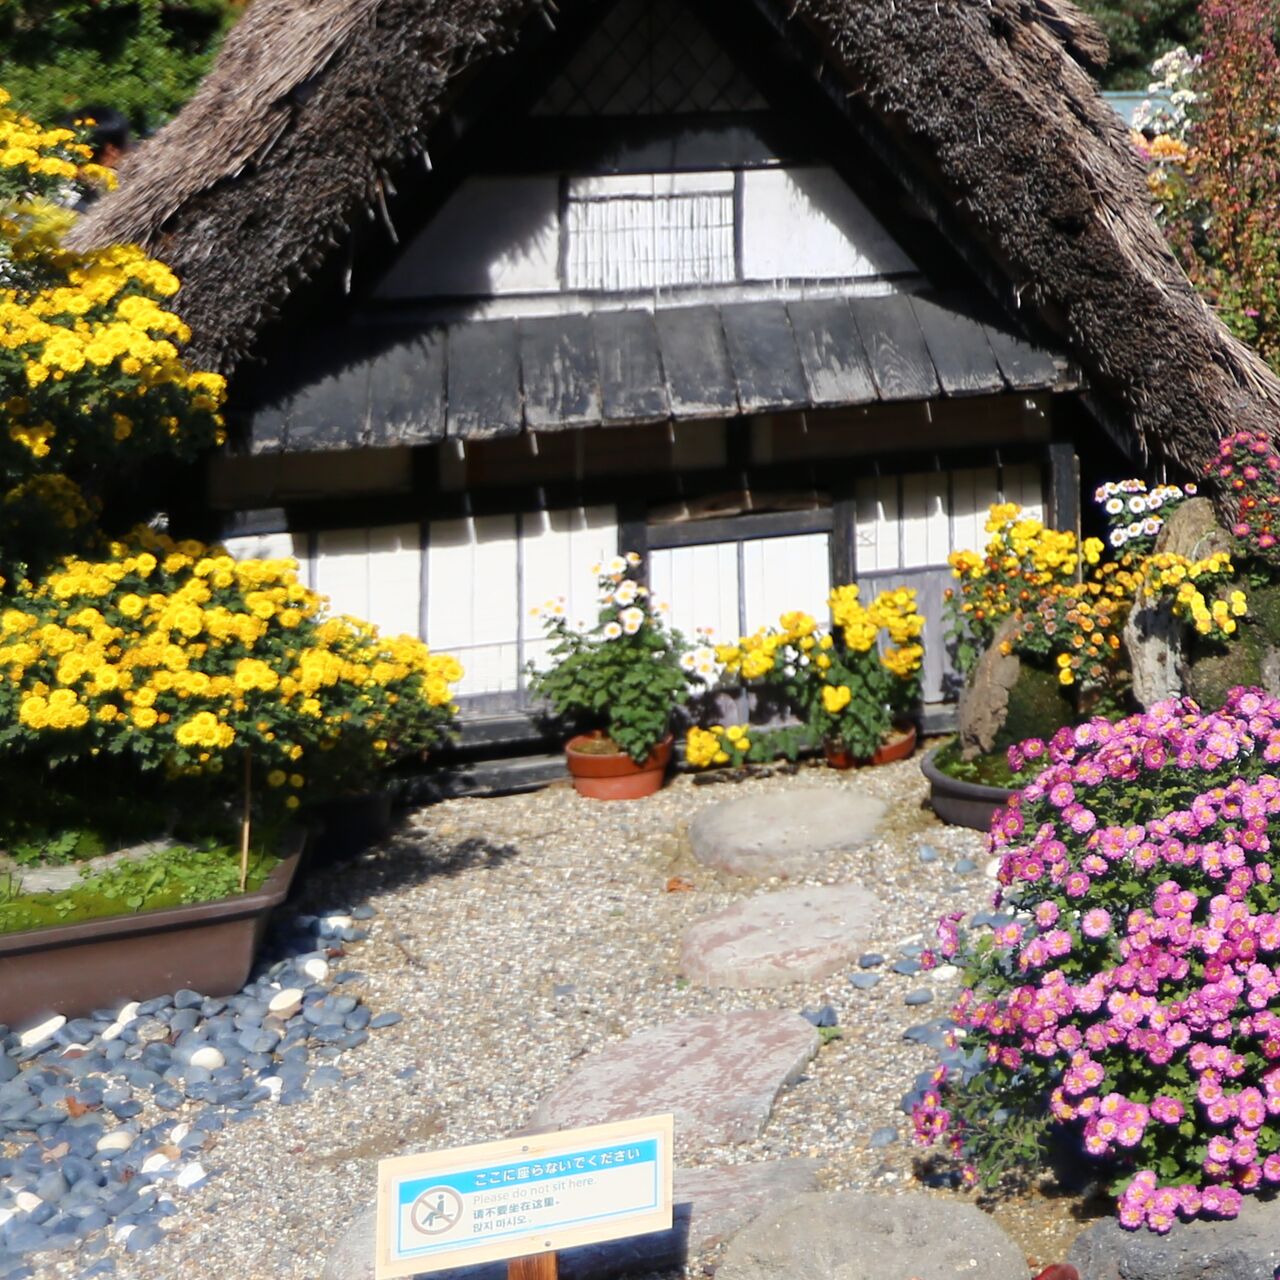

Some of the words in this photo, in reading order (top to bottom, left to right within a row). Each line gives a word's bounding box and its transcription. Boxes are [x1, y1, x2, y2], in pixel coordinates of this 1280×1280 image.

[475, 1148, 640, 1186] ここに座らないでください
[473, 1192, 510, 1205] Please
[512, 1188, 528, 1199] do
[530, 1184, 550, 1195] not
[552, 1180, 566, 1190] sit
